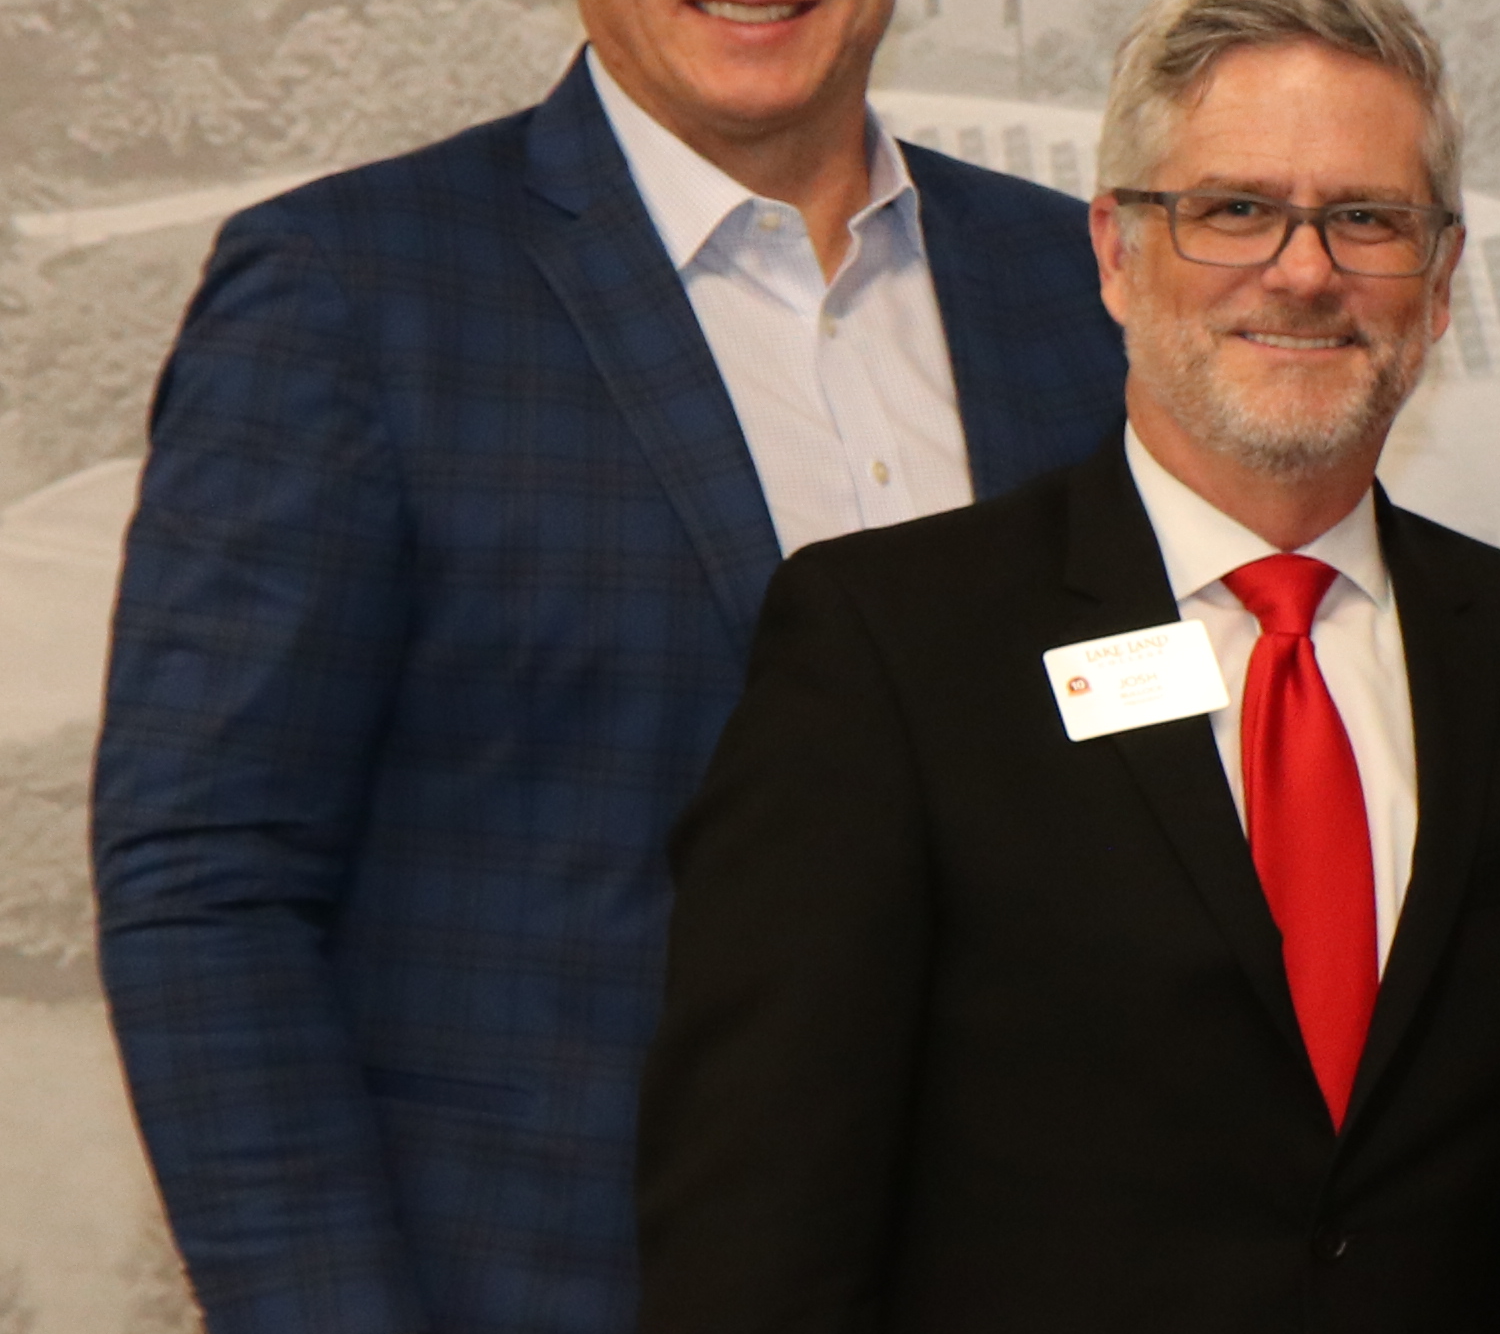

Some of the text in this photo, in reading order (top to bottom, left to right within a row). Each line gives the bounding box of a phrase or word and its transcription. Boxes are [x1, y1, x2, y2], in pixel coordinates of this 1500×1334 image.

[1085, 634, 1169, 663] LAKE LAND
[1119, 672, 1158, 689] JOSH
